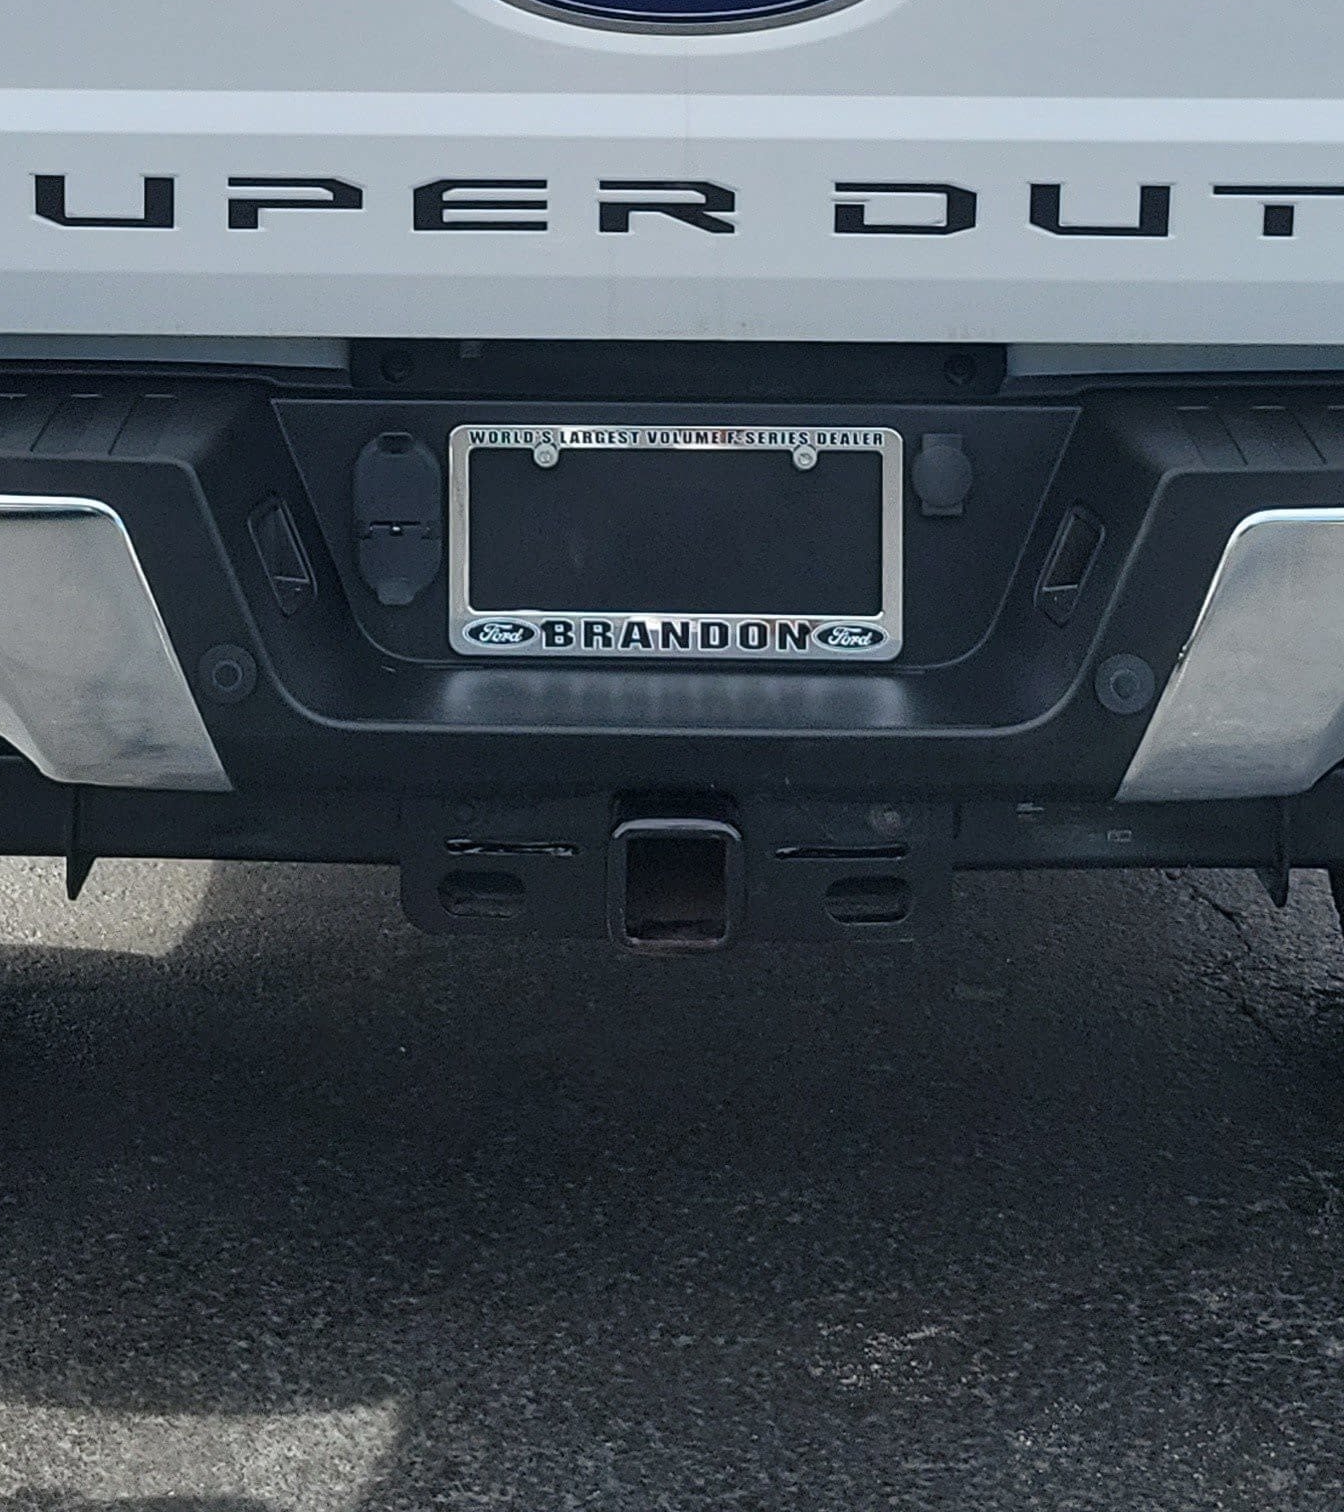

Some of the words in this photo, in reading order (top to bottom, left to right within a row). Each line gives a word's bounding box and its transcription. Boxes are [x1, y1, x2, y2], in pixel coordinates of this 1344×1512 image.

[469, 430, 552, 444] WORLD'S
[559, 430, 640, 445] LARGEST
[647, 431, 719, 445] VOLUME
[816, 432, 884, 446] DEALER
[478, 622, 524, 643] Ford
[540, 618, 813, 652] BRANDON
[827, 625, 873, 647] Ford
